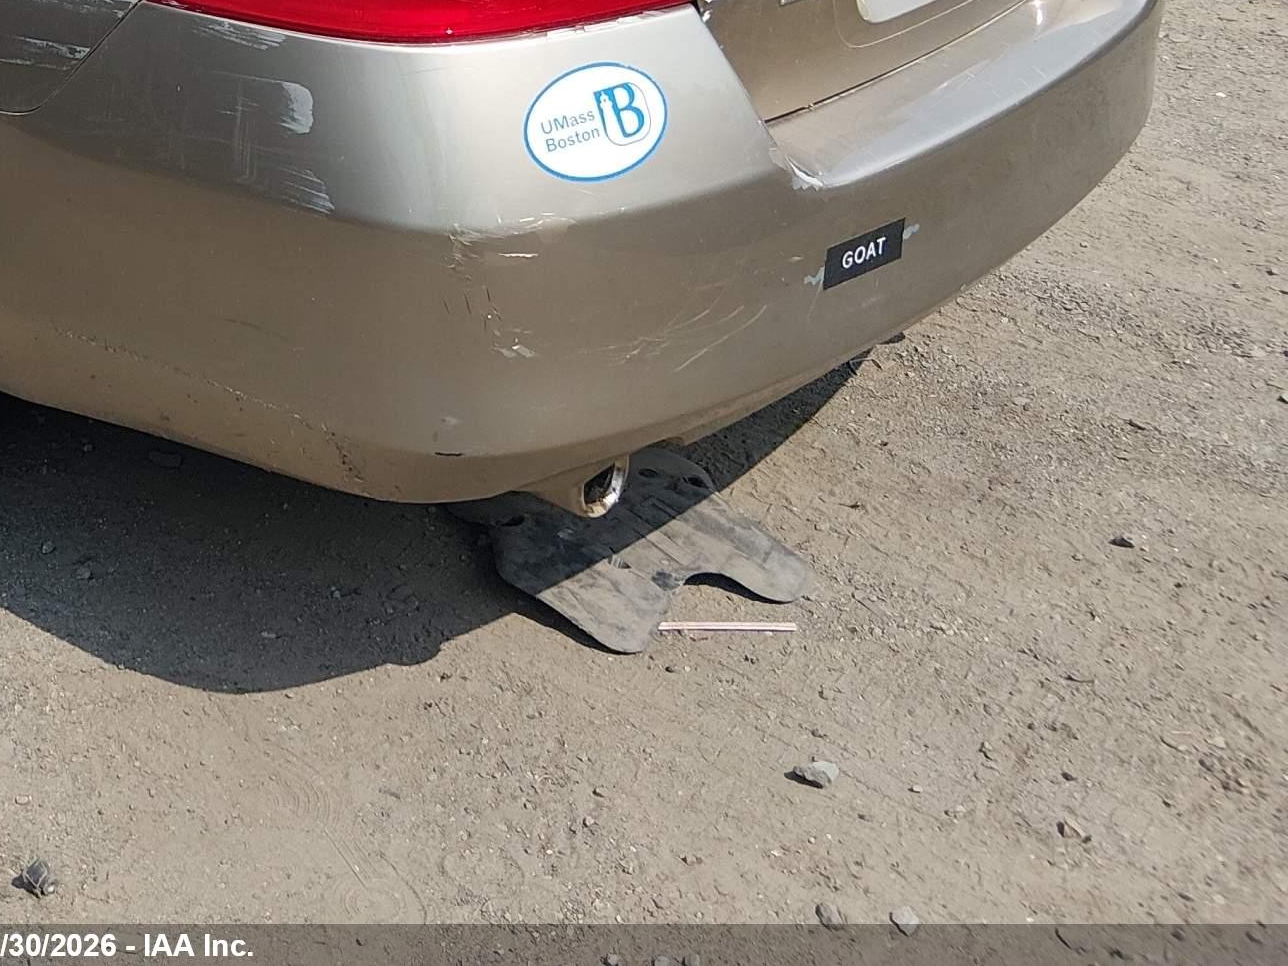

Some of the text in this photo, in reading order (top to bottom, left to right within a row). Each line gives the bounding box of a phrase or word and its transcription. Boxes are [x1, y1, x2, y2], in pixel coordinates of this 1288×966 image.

[541, 110, 595, 135] UMass
[545, 127, 600, 152] Boston
[842, 237, 886, 269] GOAT
